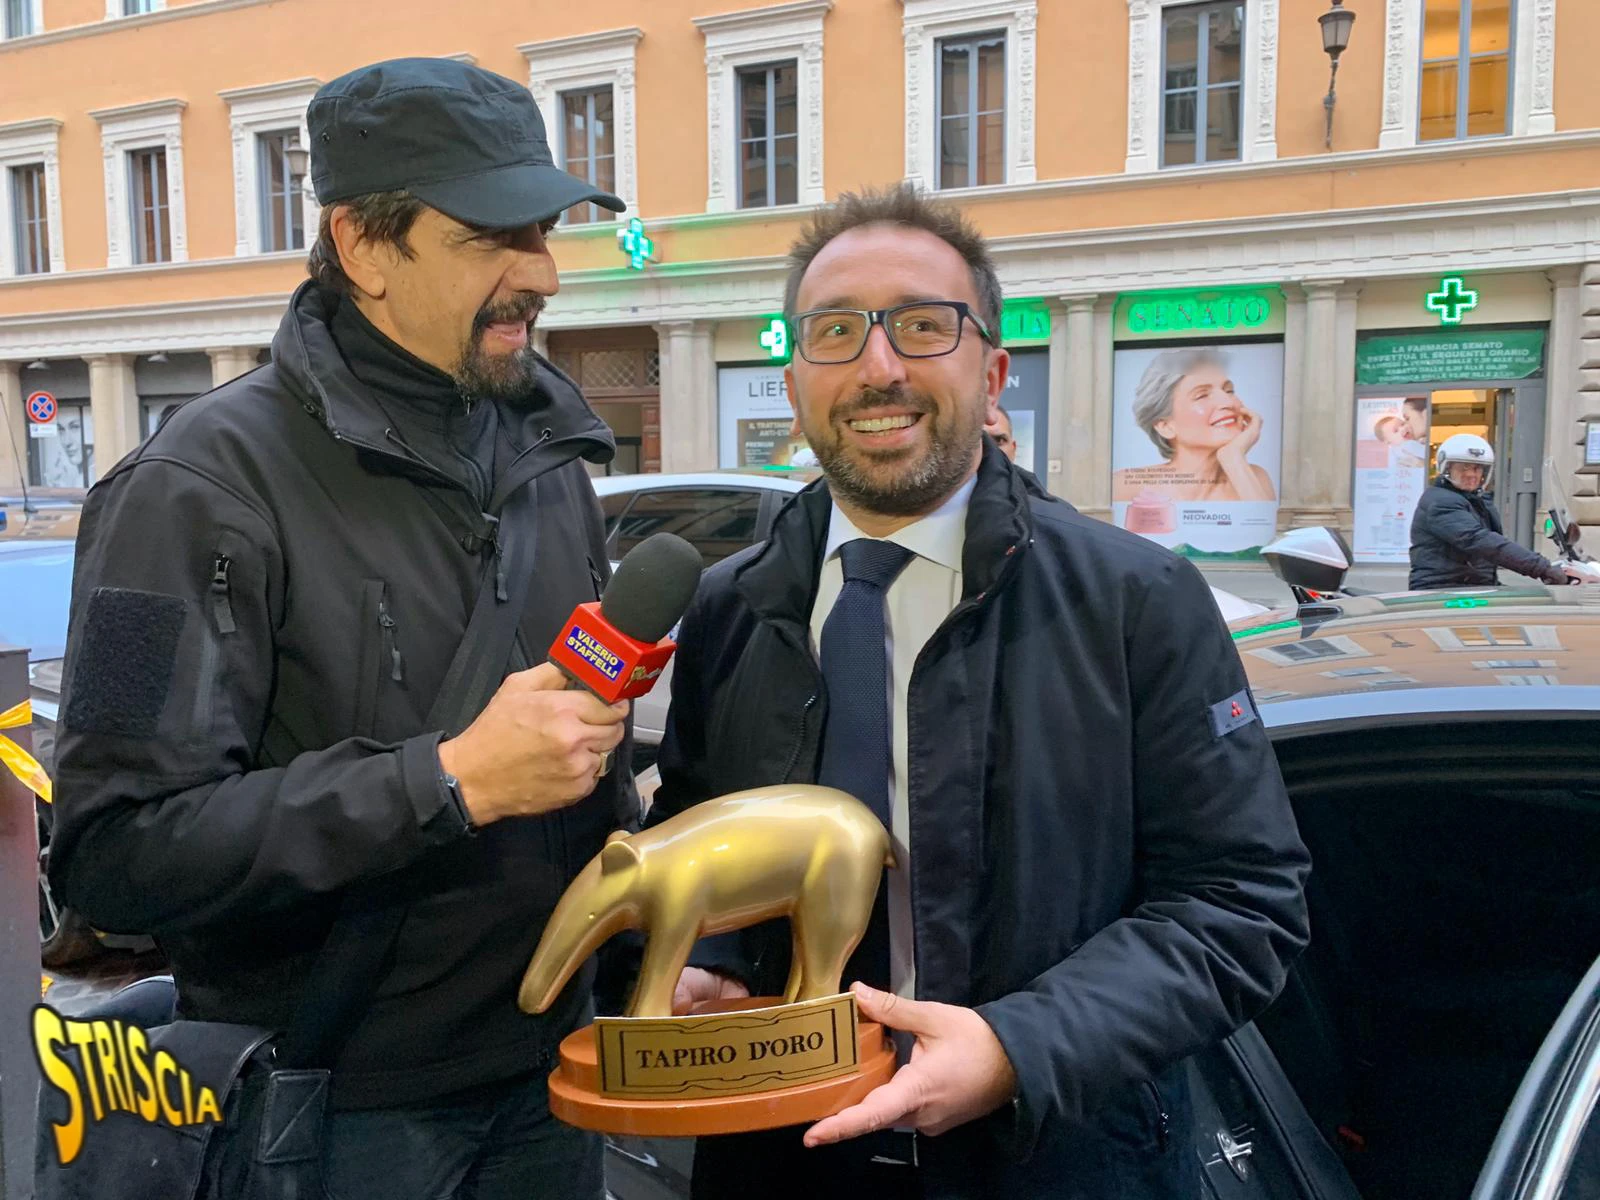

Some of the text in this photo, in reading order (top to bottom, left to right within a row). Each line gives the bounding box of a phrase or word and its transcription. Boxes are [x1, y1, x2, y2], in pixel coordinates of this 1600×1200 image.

[1133, 300, 1264, 329] SENATO
[1408, 343, 1459, 352] FARMACIA
[1462, 341, 1503, 349] SENATO
[1432, 350, 1486, 359] SEGUENTE
[1183, 513, 1232, 521] NEOVADIOL
[567, 636, 618, 679] STAFFELLI
[577, 630, 619, 666] VALERIO
[636, 1031, 824, 1069] TAPIRO D'ORO
